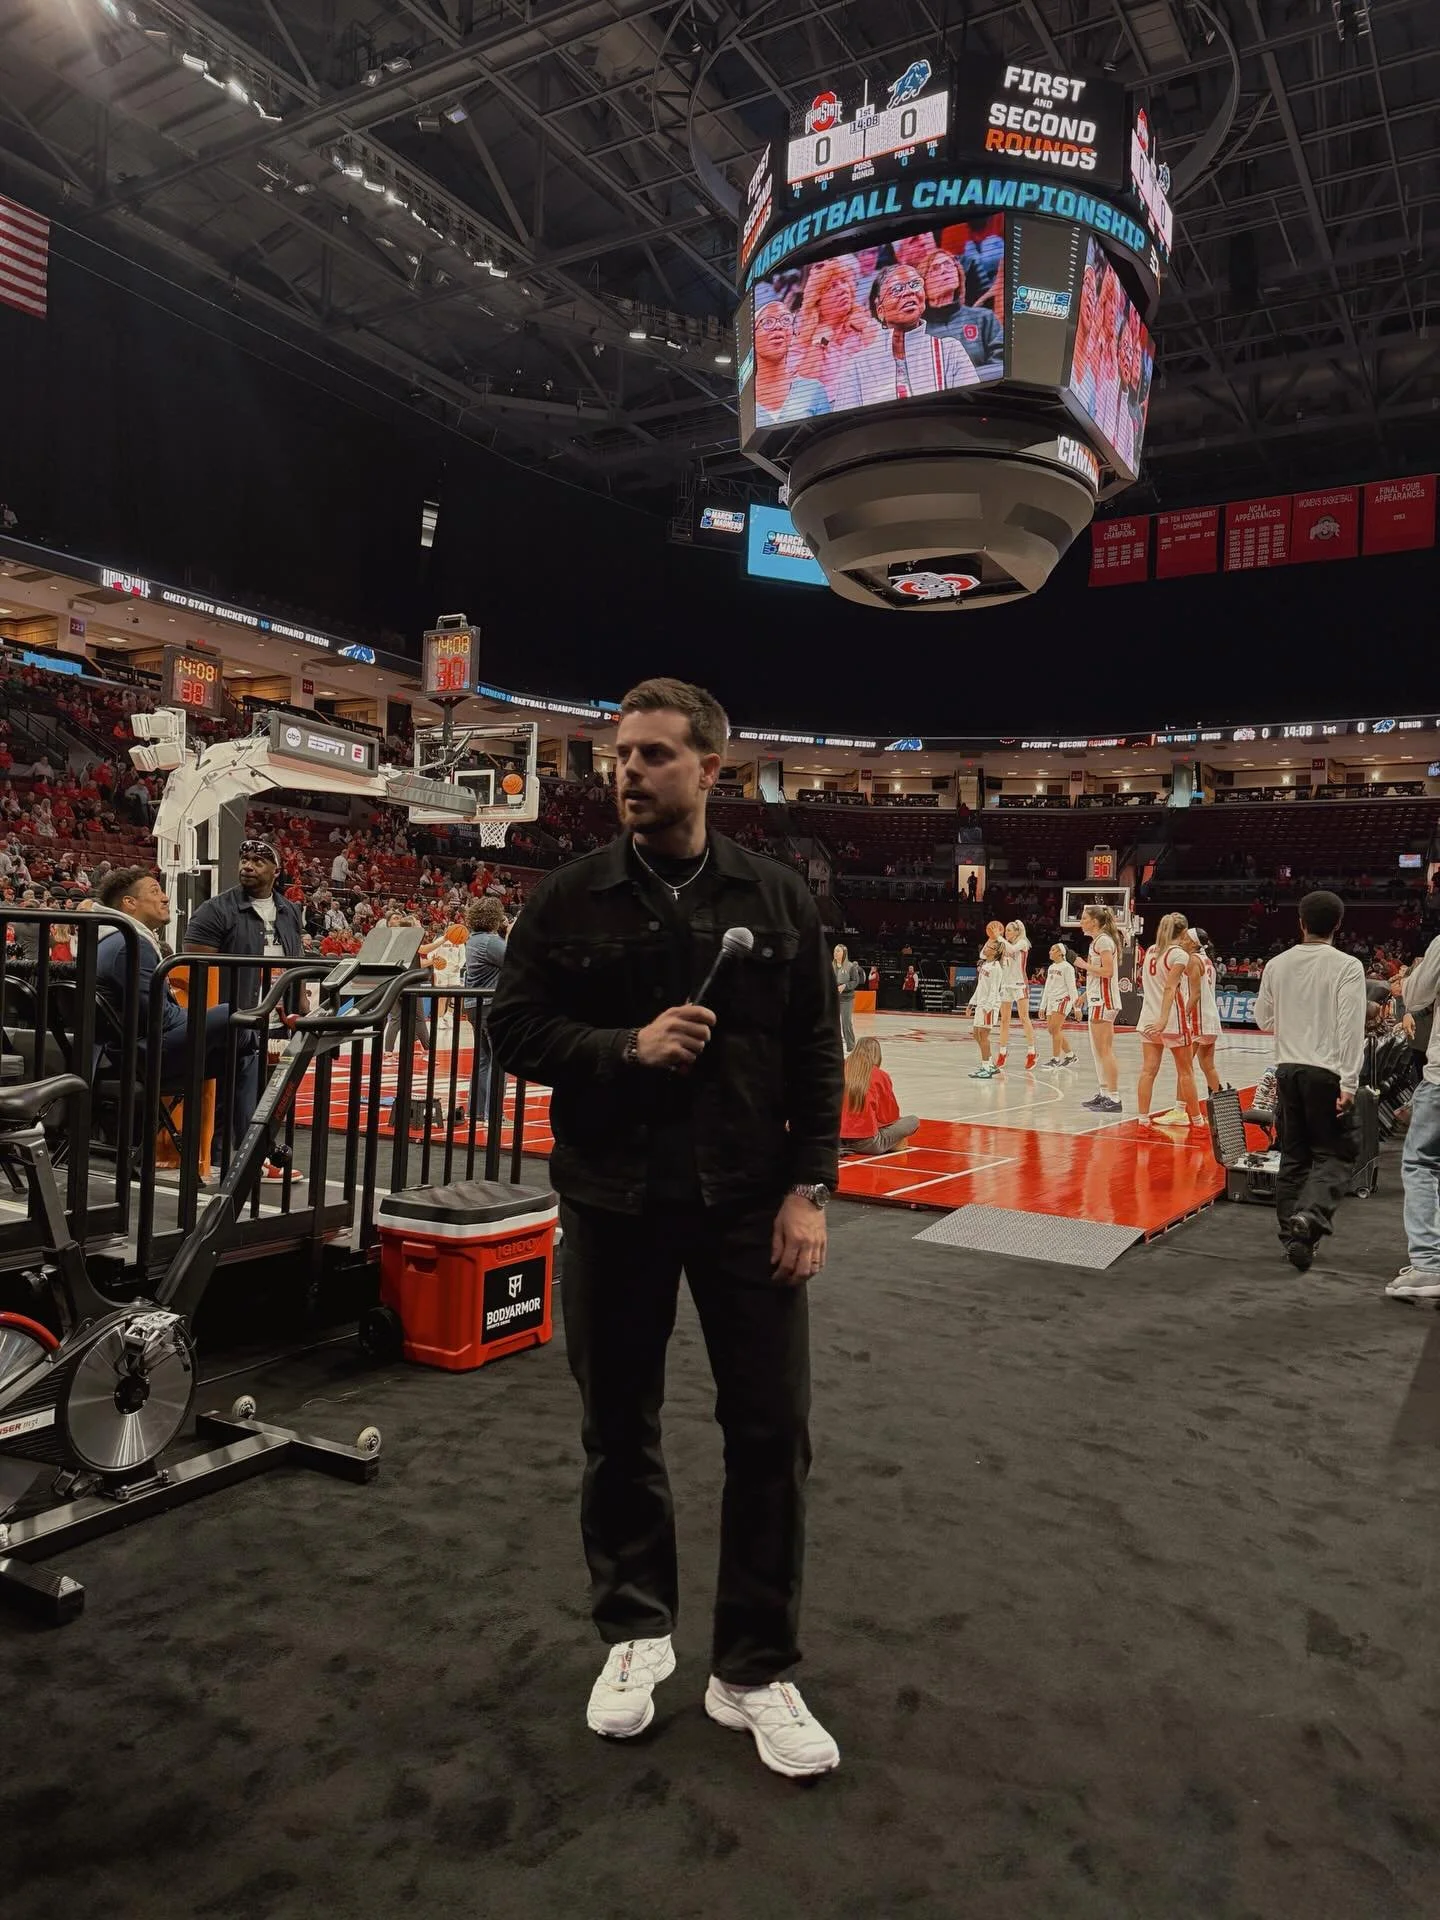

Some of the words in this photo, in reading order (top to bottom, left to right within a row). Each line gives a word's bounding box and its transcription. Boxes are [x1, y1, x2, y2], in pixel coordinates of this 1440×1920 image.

[1004, 66, 1086, 102] FIRST
[1033, 97, 1053, 109] AND
[989, 103, 1097, 143] SECOND
[816, 136, 830, 167] 0
[900, 107, 917, 140] 0
[893, 147, 914, 160] FOULS
[985, 128, 1098, 170] ROUNDS
[815, 171, 834, 184] FOULS
[851, 168, 875, 181] BONUS
[911, 178, 1146, 252] CHAMPIONSHIP
[1025, 289, 1056, 303] MARCH
[1028, 300, 1069, 316] MADNESS
[1374, 489, 1425, 504] APPEARANCES
[1379, 485, 1398, 495] FINAL
[1401, 481, 1420, 492] FOUR
[1234, 509, 1281, 523] APPEARANCES
[1248, 503, 1267, 514] NCAA
[775, 533, 804, 546] MARCH
[1103, 528, 1136, 541] CHAMPIONS
[163, 591, 187, 606] OHIO
[188, 598, 215, 614] STATE
[215, 606, 259, 627] BUCKEYES
[271, 623, 305, 640] HOWARD
[304, 634, 330, 648] BISON
[438, 635, 470, 655] 14:08
[179, 659, 216, 682] 14:08
[436, 655, 464, 691] 30
[506, 694, 547, 711] BASKETBALL
[547, 702, 602, 719] CHAMPIONSHIP
[1262, 727, 1269, 740] 0
[1284, 724, 1313, 738] 14:08
[1322, 725, 1337, 735] 1st
[1357, 721, 1365, 734] 0
[307, 734, 346, 757] ESPN
[1030, 740, 1052, 749] FIRST
[1058, 740, 1088, 749] SECOND
[486, 1297, 541, 1326] BODYARMOR
